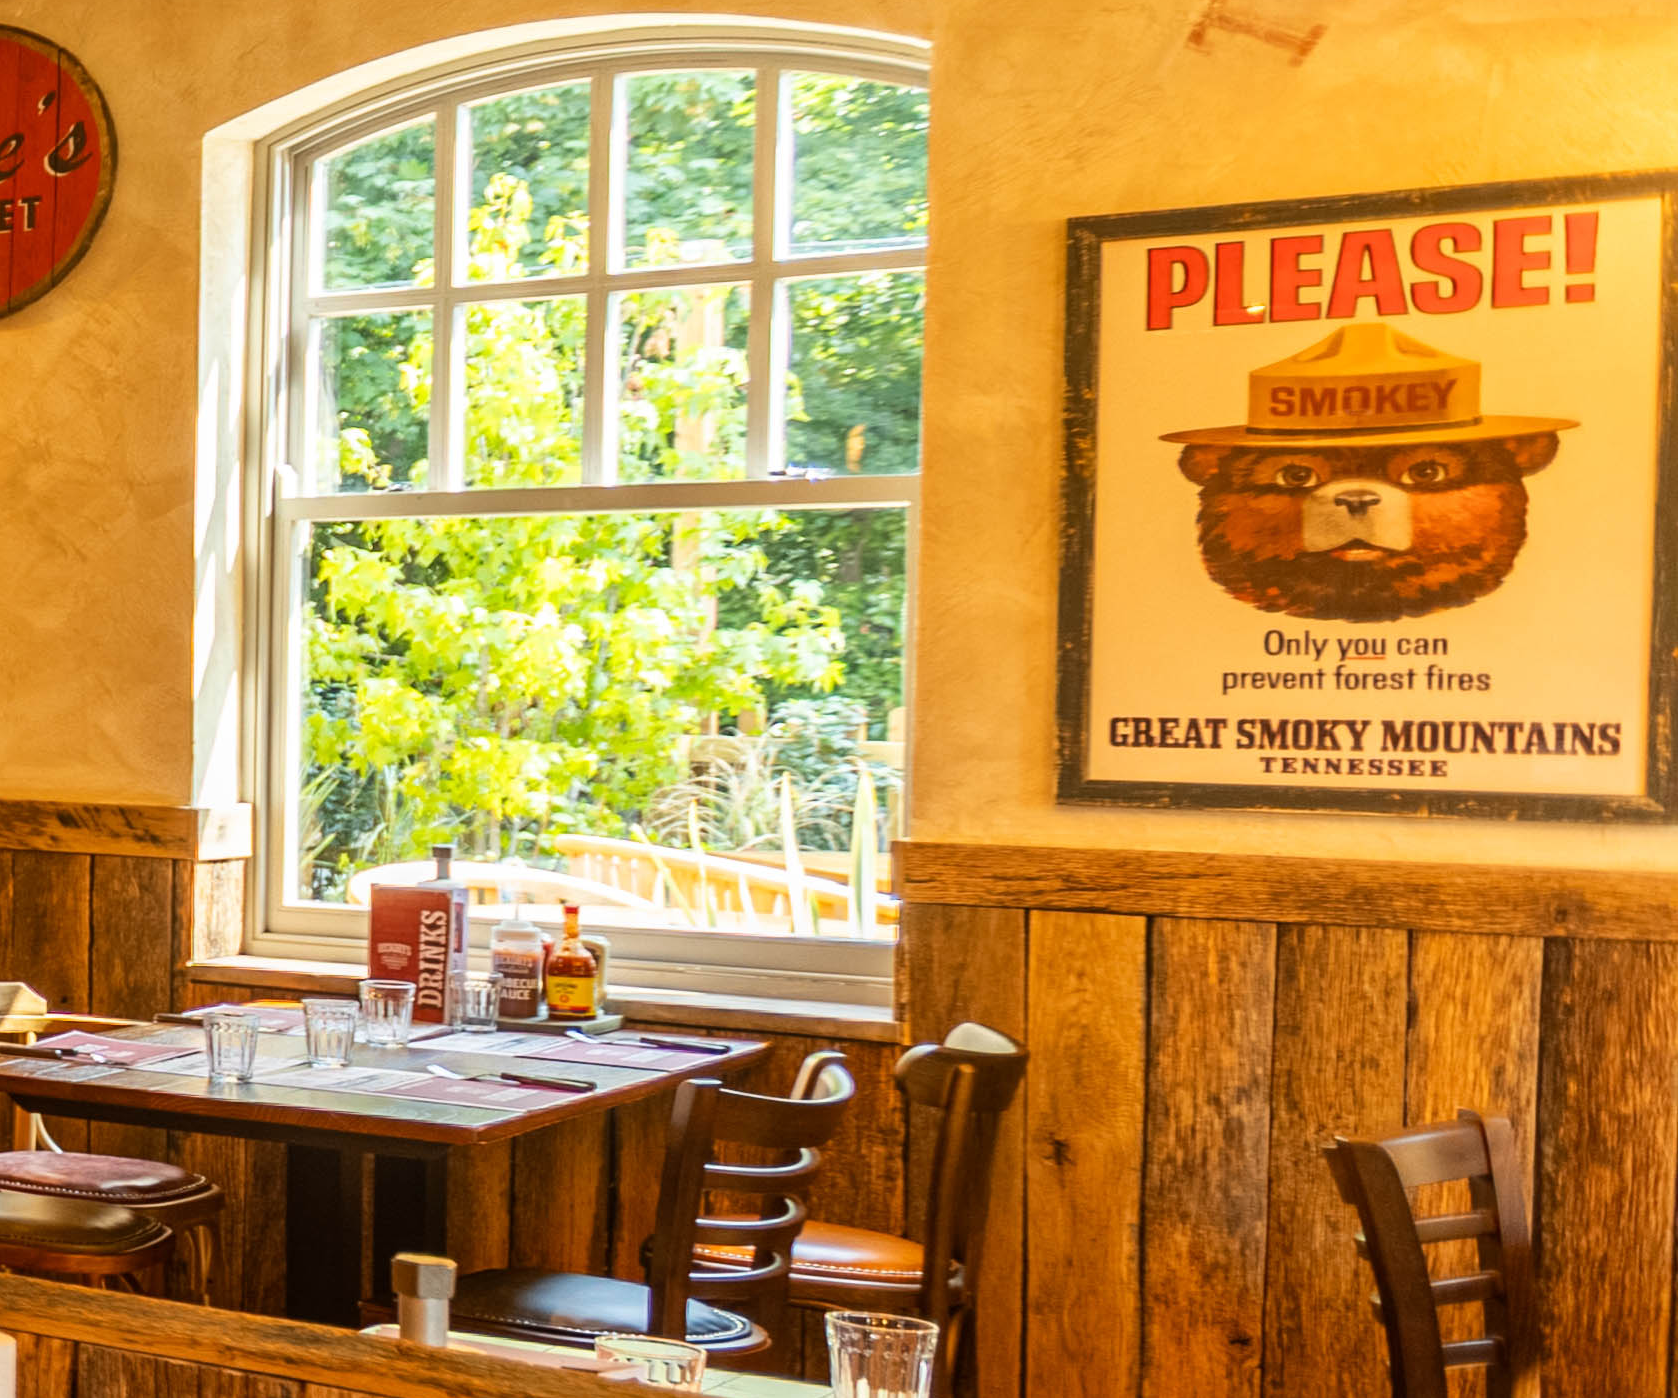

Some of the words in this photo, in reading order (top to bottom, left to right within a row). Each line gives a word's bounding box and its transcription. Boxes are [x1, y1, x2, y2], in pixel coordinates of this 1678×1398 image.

[1145, 210, 1599, 331] PLEASE!
[1269, 378, 1458, 419] SMOKEY
[1263, 629, 1328, 660] Only
[1338, 636, 1387, 660] you
[1397, 633, 1448, 656] can
[1222, 668, 1325, 695] prevent
[1332, 666, 1417, 691] forest
[1425, 666, 1491, 692] fires
[1109, 717, 1226, 749] GREAT
[1236, 718, 1371, 752] SMOKY
[1381, 721, 1622, 757] MOUNTAINS
[1259, 755, 1448, 777] TENNESSEE
[418, 910, 447, 1008] DRINKS
[500, 989, 531, 1000] AUCE
